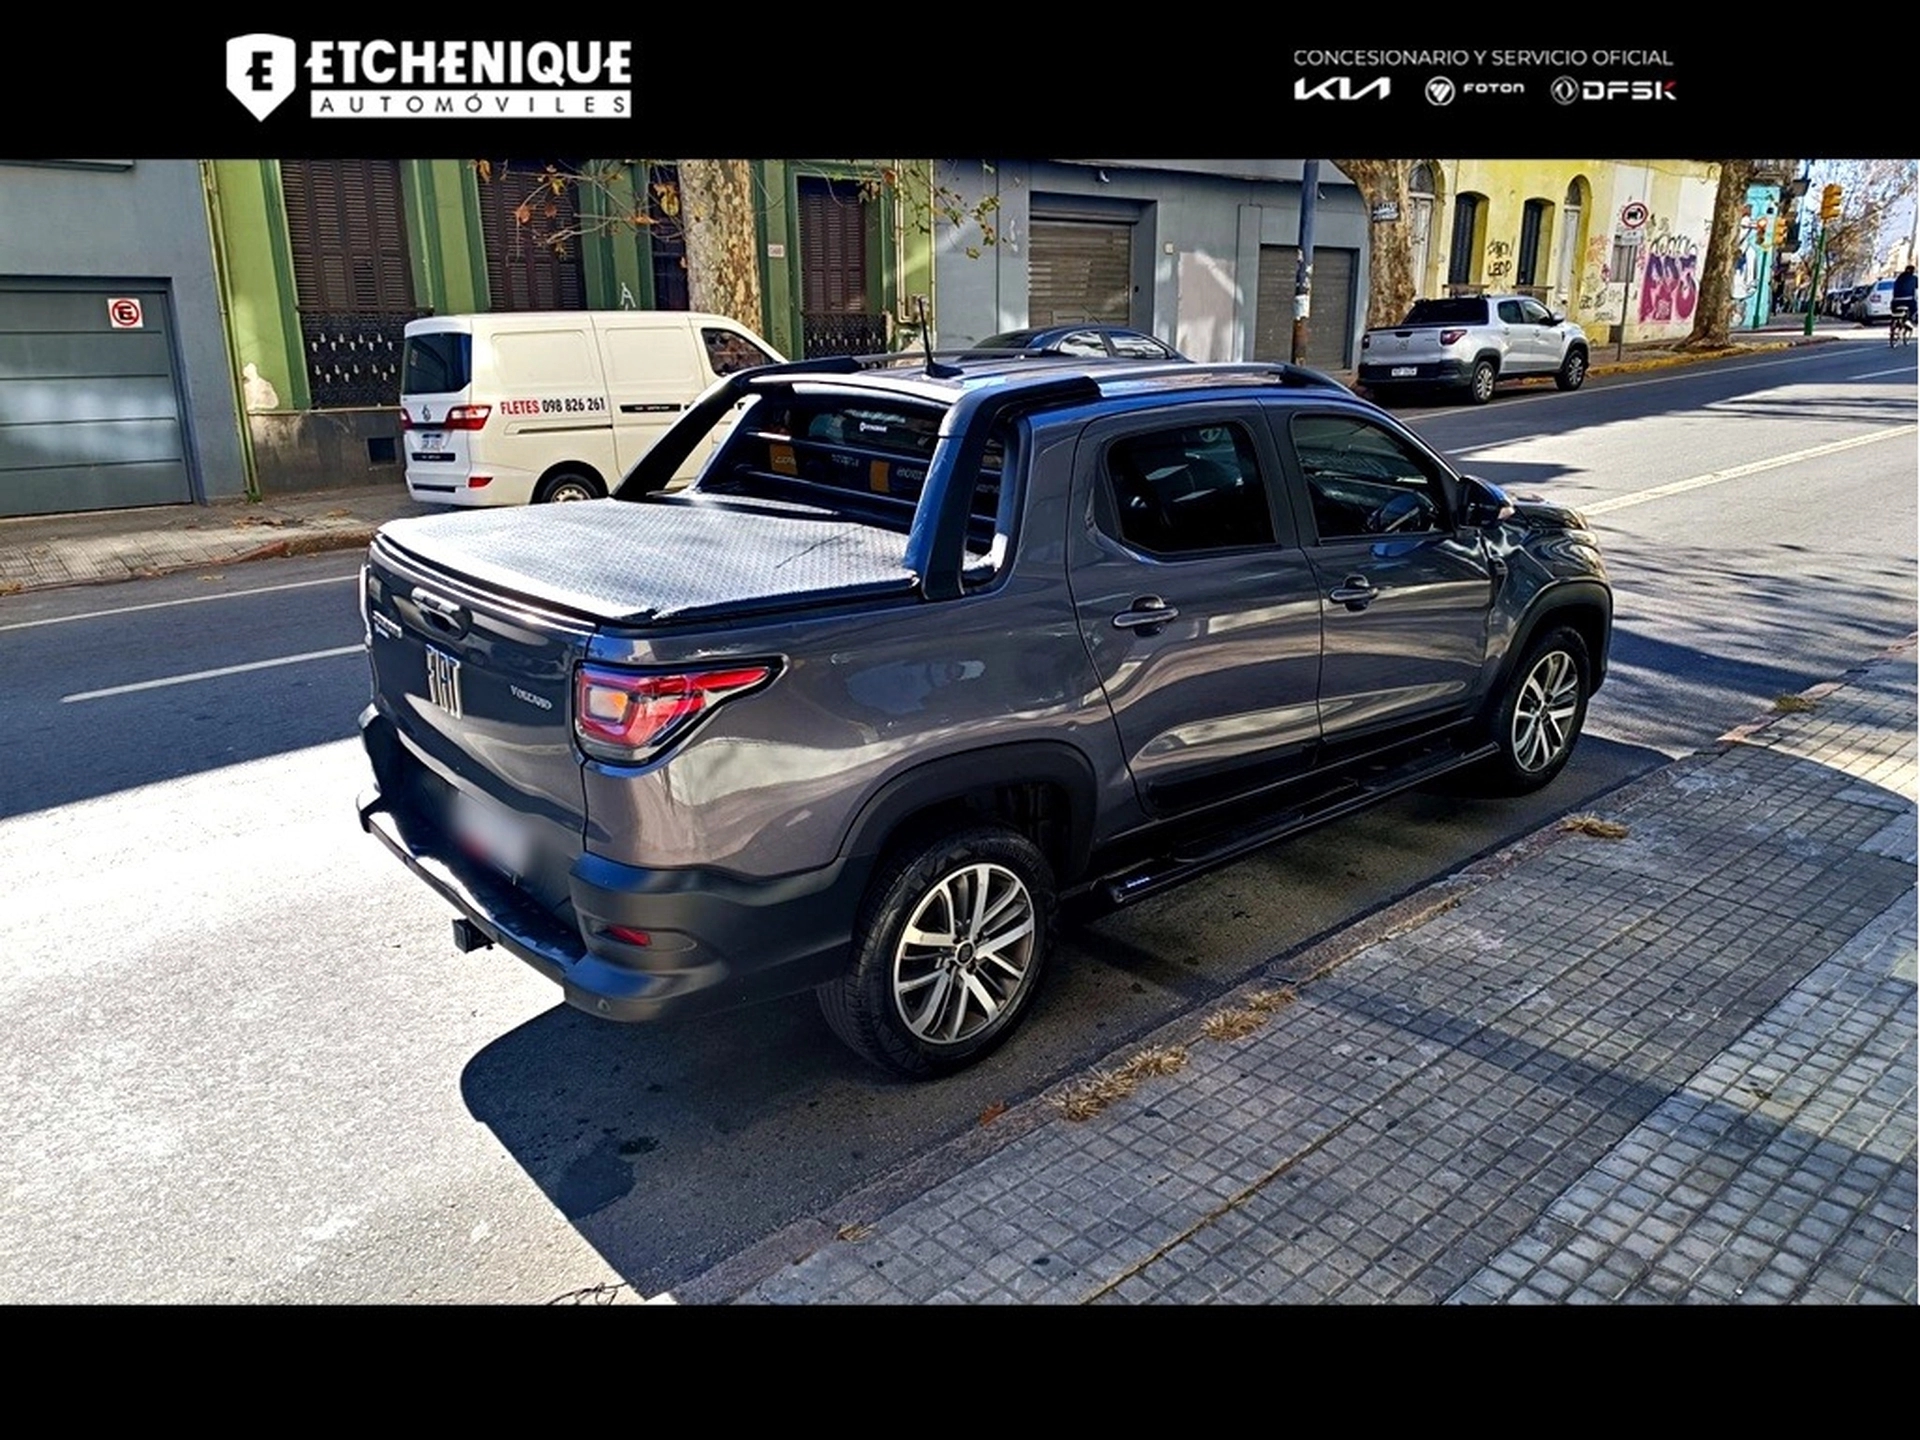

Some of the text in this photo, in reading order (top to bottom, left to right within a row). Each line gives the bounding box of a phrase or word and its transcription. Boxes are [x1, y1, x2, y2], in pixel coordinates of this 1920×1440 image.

[500, 397, 605, 415] FLETES 098 826 261
[425, 643, 462, 719] FIAT
[510, 684, 553, 711] VOLCANO
